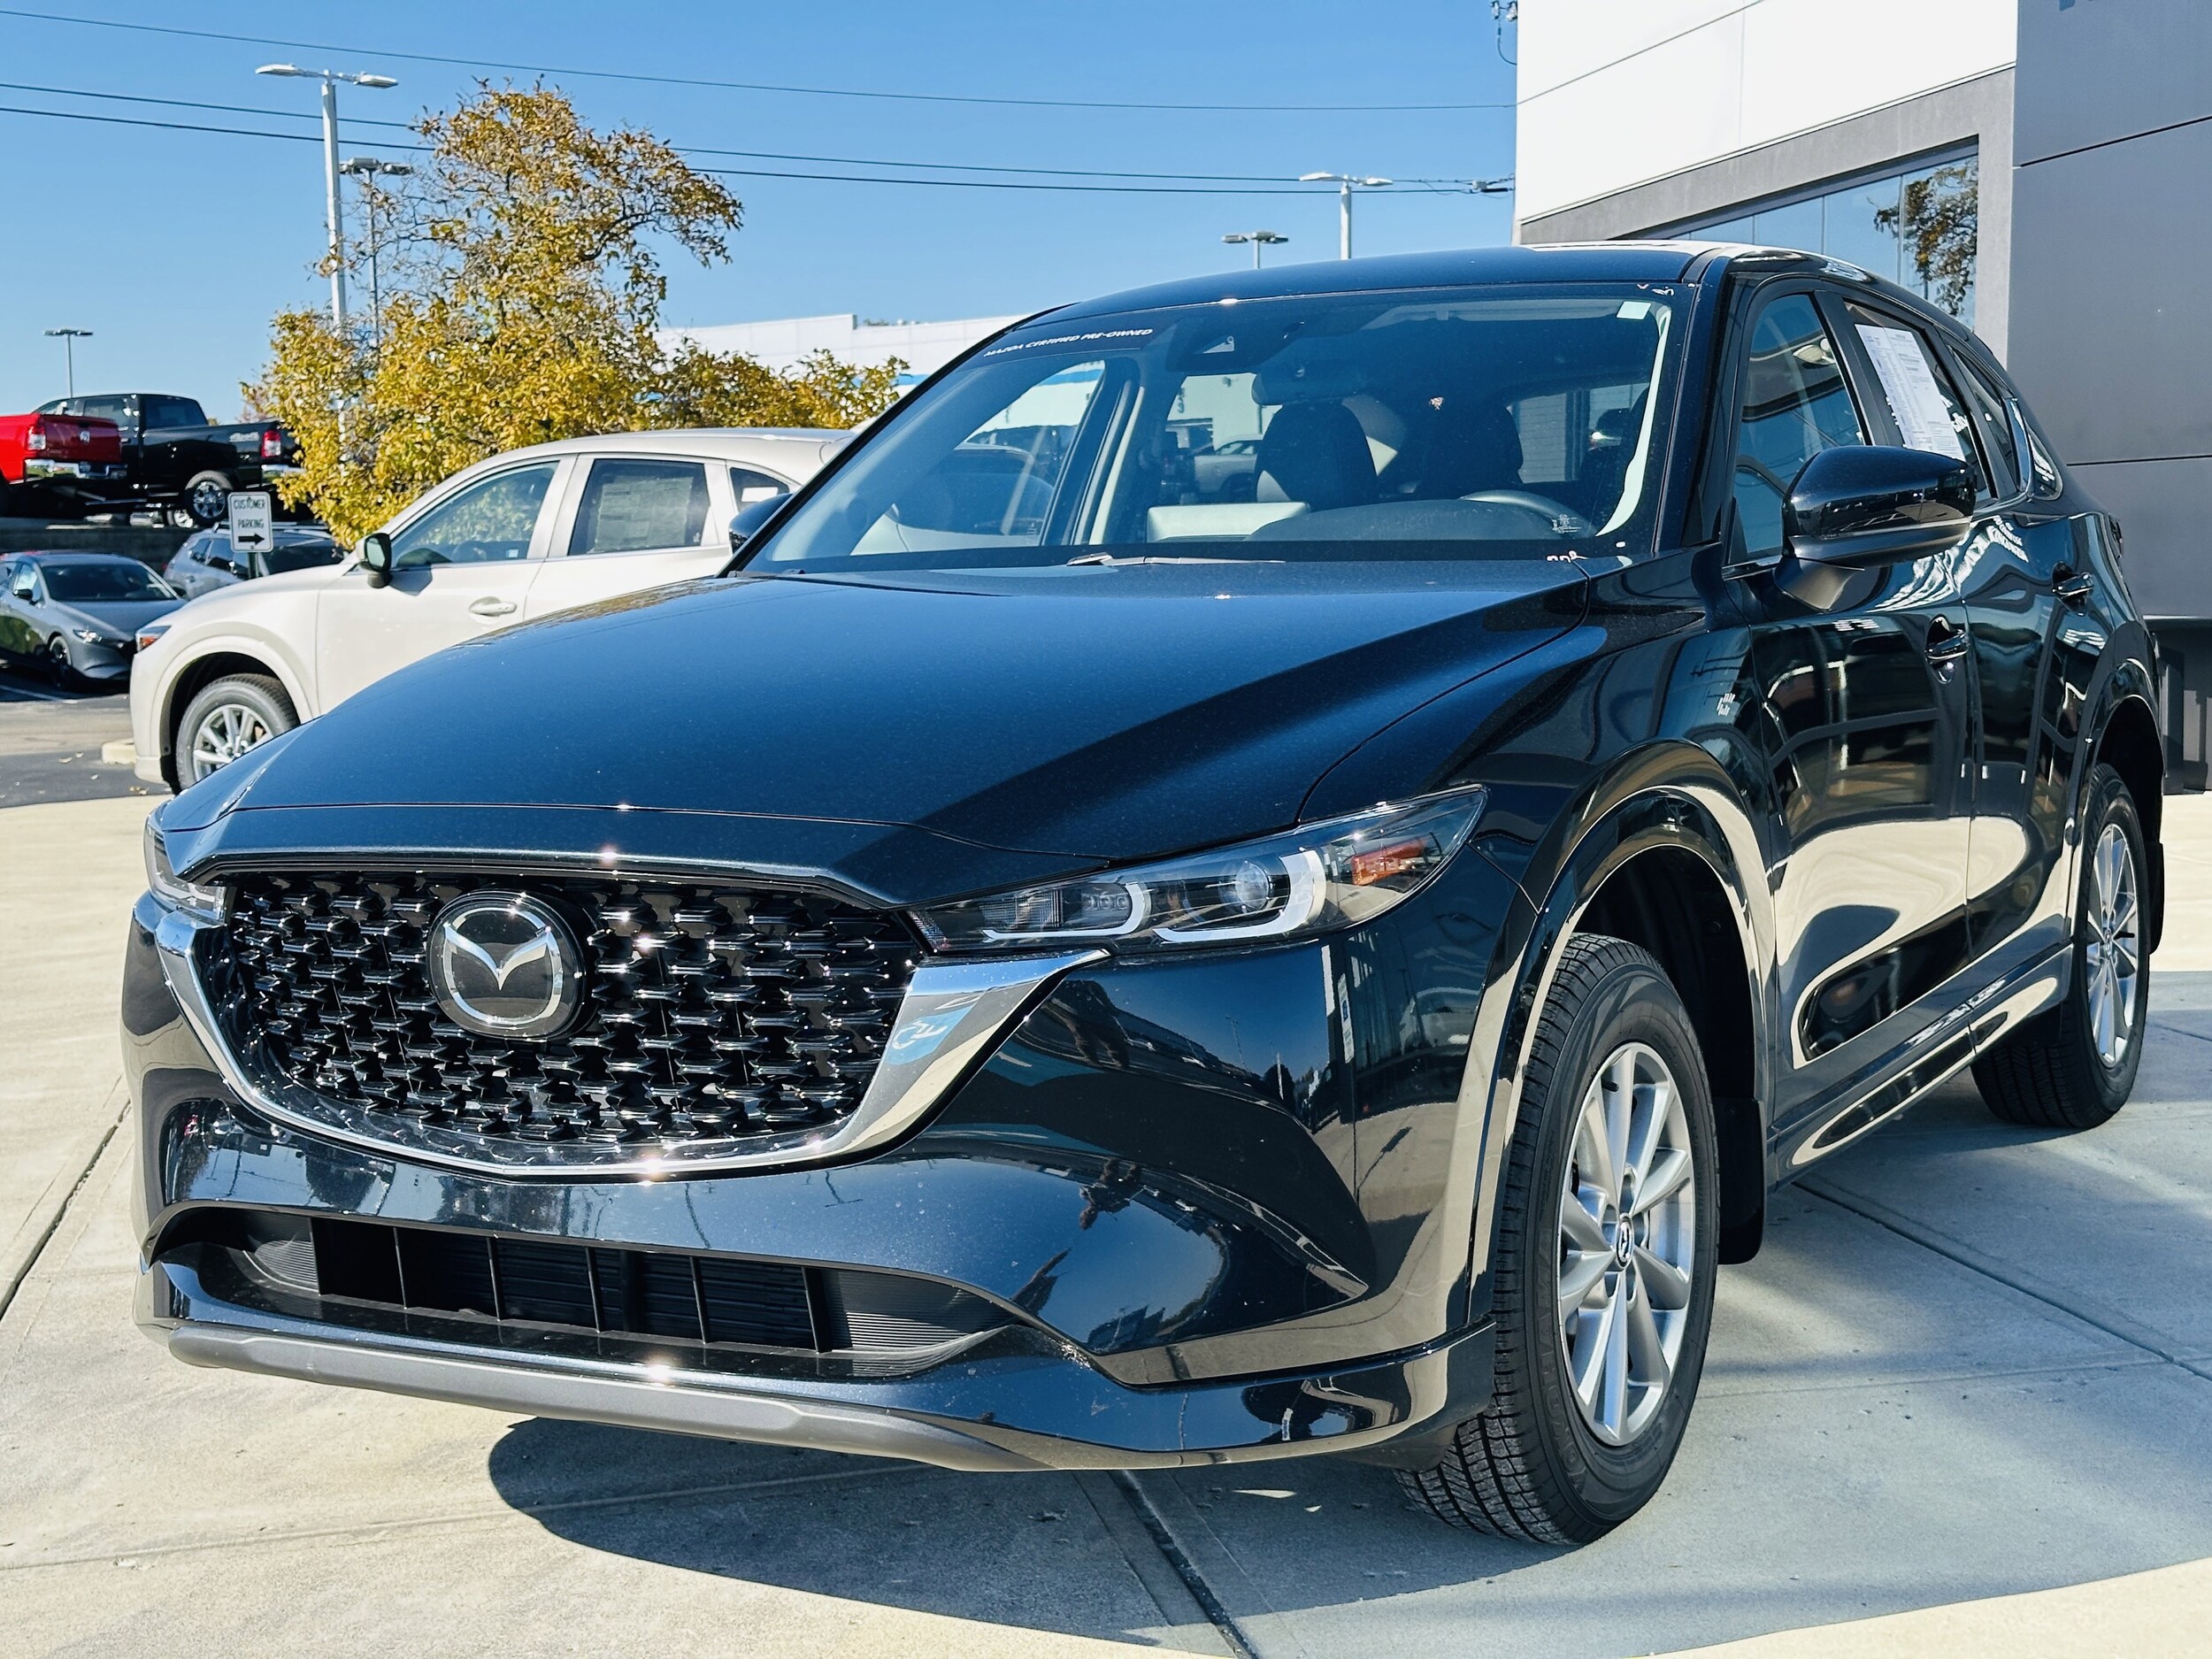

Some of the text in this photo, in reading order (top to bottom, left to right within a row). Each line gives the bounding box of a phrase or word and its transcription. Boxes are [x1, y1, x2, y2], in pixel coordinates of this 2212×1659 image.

[983, 328, 1153, 357] MAZDA CERTIFIED PRE-OWNED
[234, 499, 265, 510] CUSTOMER
[237, 518, 265, 529] PARKING
[1535, 1228, 1587, 1494] YOKOHAMA
